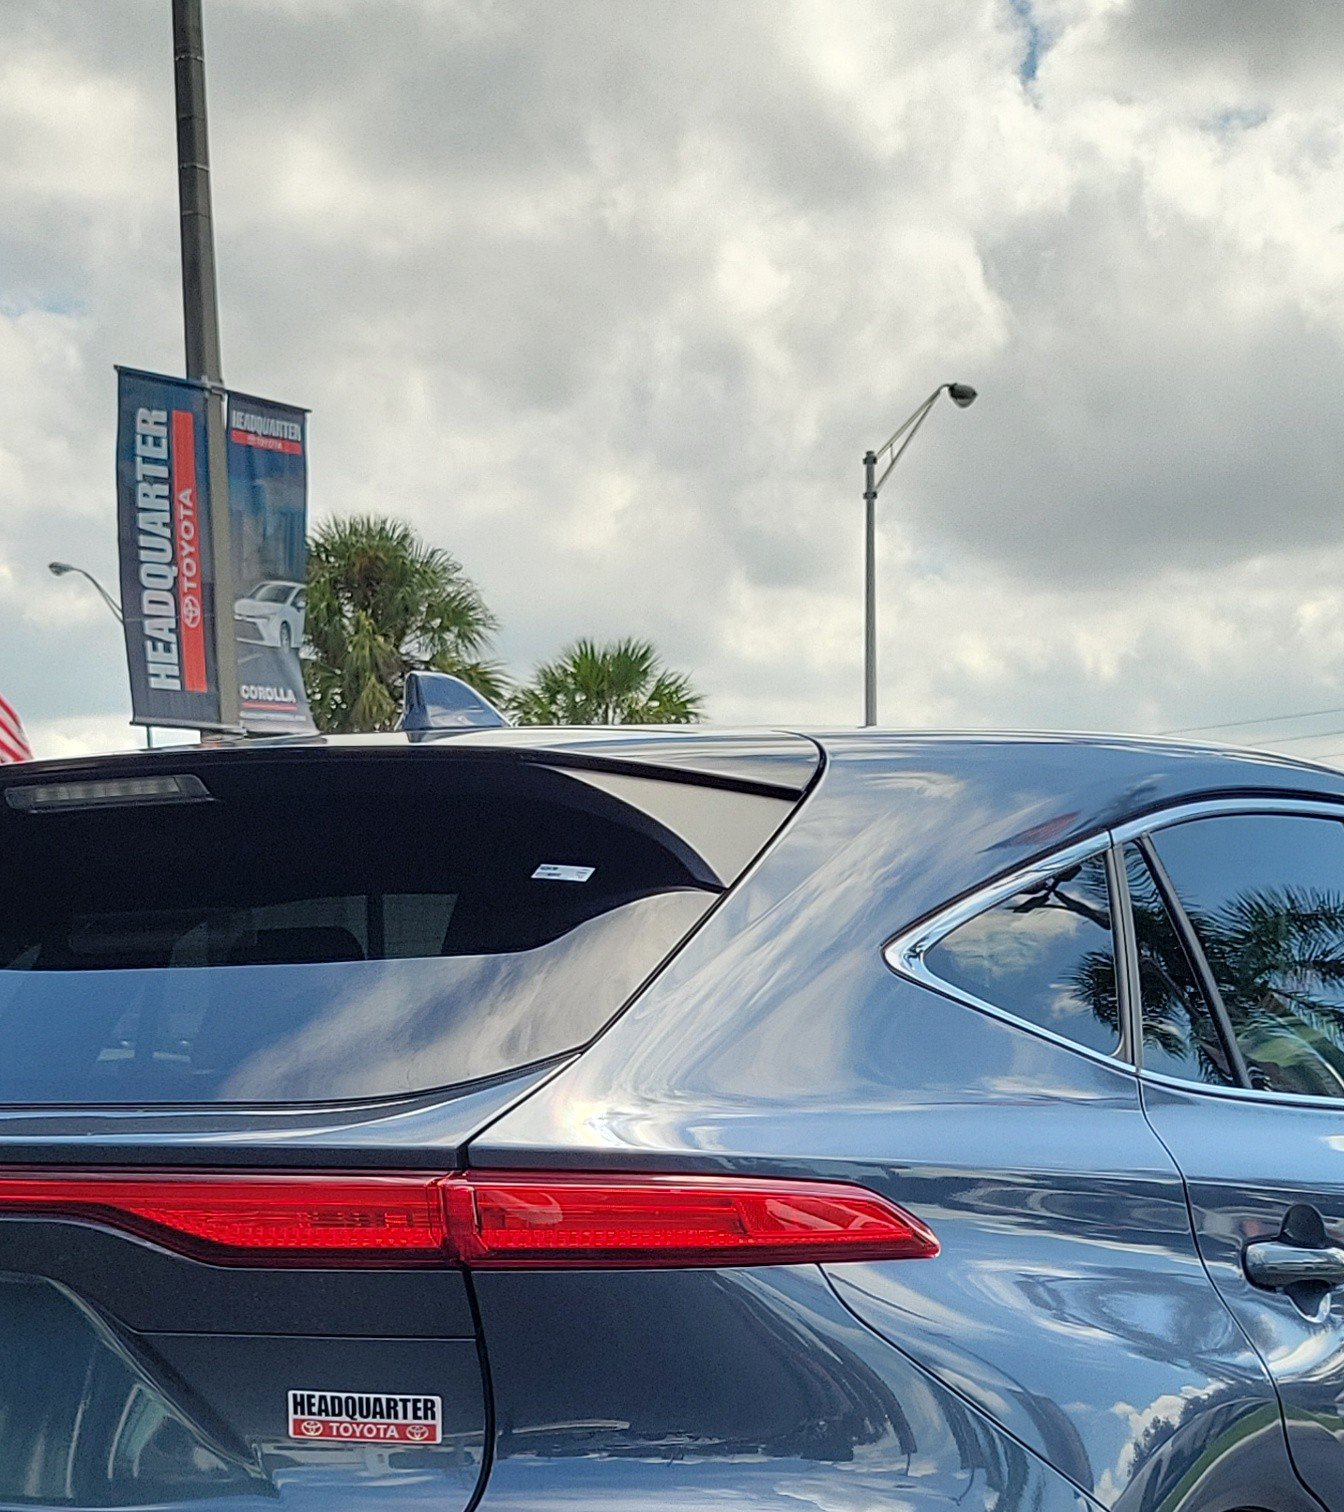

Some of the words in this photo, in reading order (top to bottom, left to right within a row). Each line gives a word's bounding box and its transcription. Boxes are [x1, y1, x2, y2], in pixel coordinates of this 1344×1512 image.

[232, 410, 301, 442] HEADQUARTER
[136, 407, 182, 691] HEADQUARTER
[177, 488, 200, 592] TOYOTA
[240, 684, 296, 703] COROLLA
[292, 1393, 436, 1421] HEADQUARTER
[329, 1422, 399, 1438] TOYOTA
